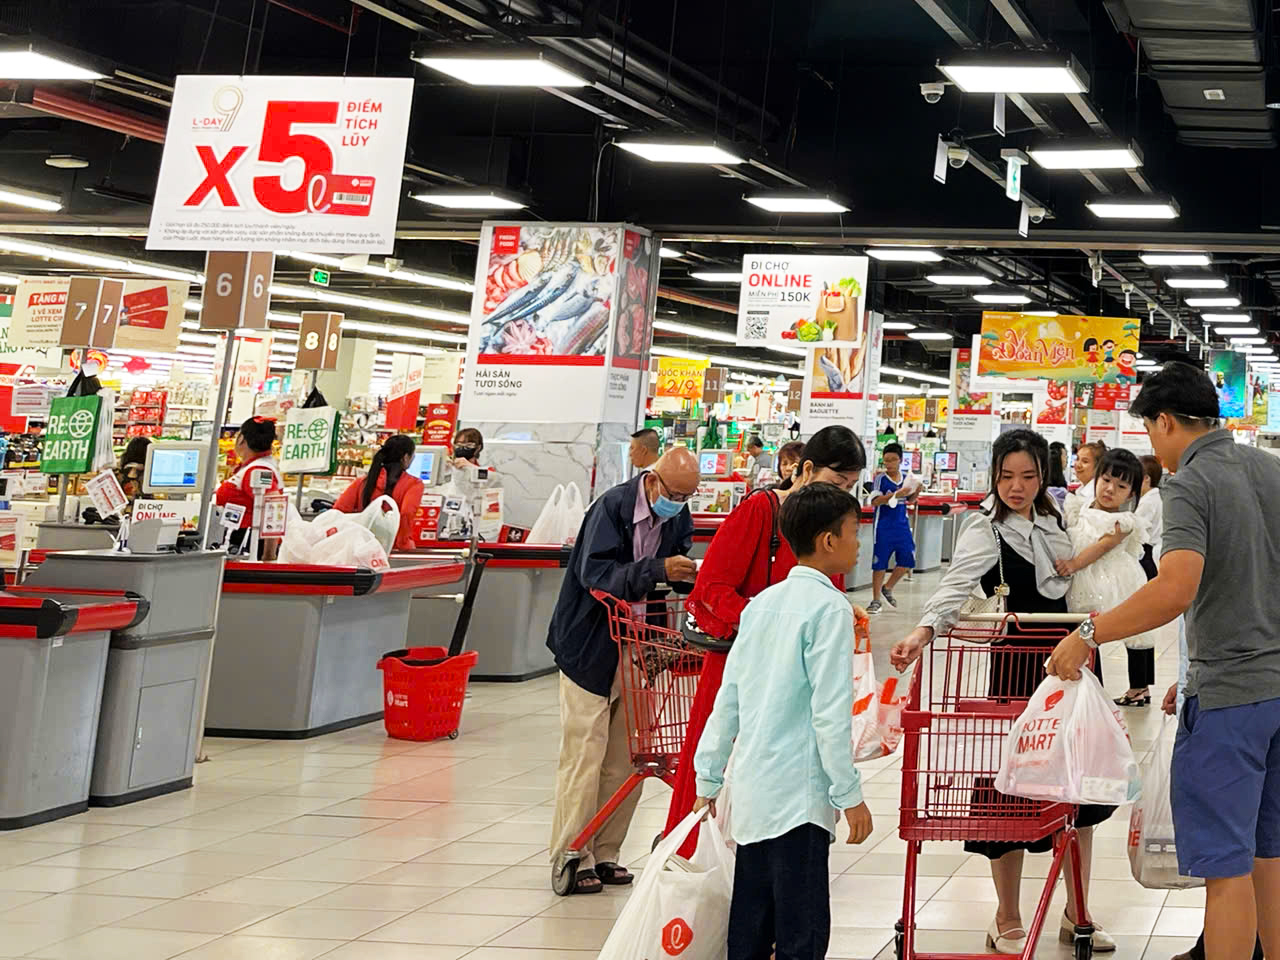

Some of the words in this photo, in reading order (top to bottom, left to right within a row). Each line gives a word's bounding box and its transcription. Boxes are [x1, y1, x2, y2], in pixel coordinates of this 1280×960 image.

[347, 98, 383, 113] ĐIỂM
[192, 117, 224, 126] L-DAY
[345, 116, 378, 130] TÍCH
[341, 132, 370, 147] LŨY
[751, 261, 763, 270] ĐI
[765, 261, 790, 272] CHỢ
[215, 272, 233, 297] 6
[253, 273, 265, 298] 6
[748, 273, 812, 288] ONLINE
[780, 291, 812, 302] 150K
[74, 302, 87, 321] 7
[102, 304, 113, 324] 7
[304, 331, 319, 350] 8
[328, 332, 338, 351] 8
[475, 370, 491, 378] HẢI
[492, 369, 511, 378] SẢN
[498, 379, 523, 388] SỐNG
[667, 379, 695, 393] 2/9
[705, 380, 718, 391] 11
[789, 391, 801, 400] 12
[43, 440, 89, 461] EARTH
[285, 442, 326, 460] EARTH
[1016, 733, 1056, 754] MART
